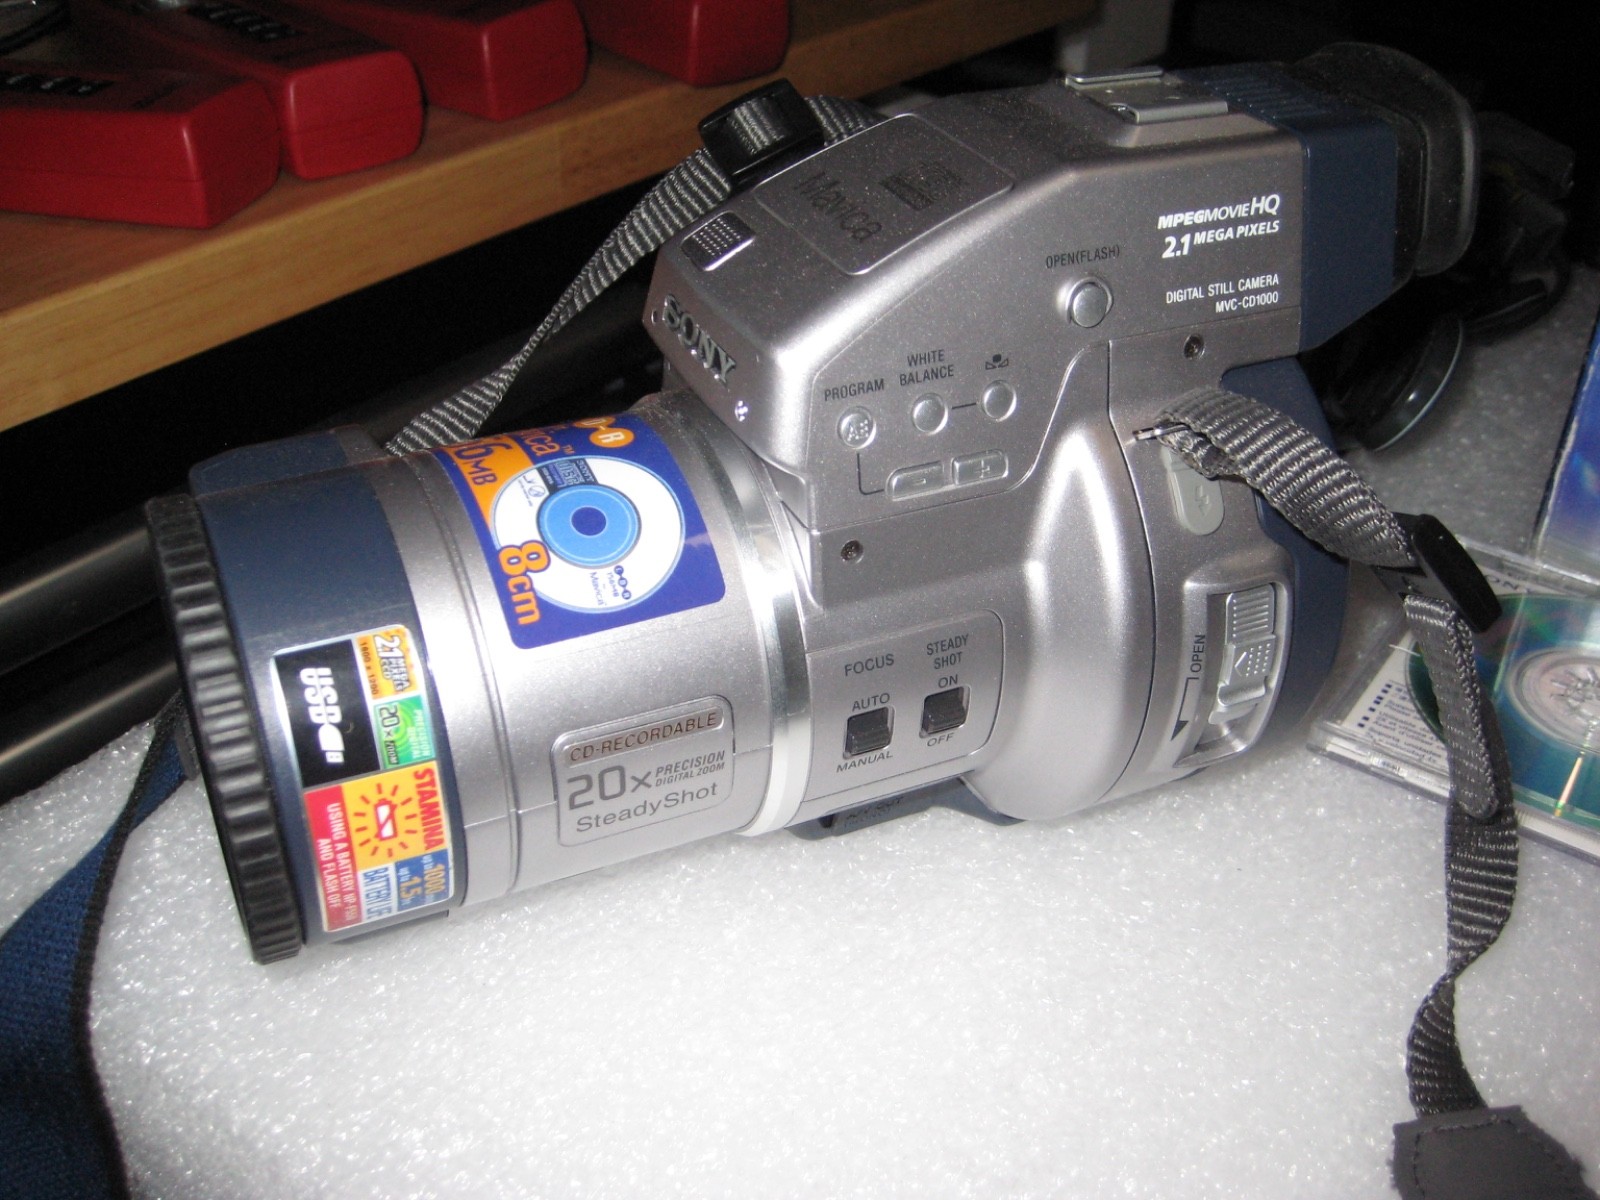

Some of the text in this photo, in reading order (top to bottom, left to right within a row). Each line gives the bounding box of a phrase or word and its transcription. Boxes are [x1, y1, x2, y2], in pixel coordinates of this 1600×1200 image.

[1162, 220, 1280, 259] 2.1 MEGA PIXELS
[1166, 274, 1280, 304] DIGITAL STILL CAMERA
[1215, 291, 1279, 313] MVC-CD1000
[662, 292, 737, 385] SONY
[907, 349, 945, 367] WHITE
[899, 365, 955, 386] BALANCE
[824, 378, 885, 402] PROGRAM
[498, 539, 552, 626] 8cm
[926, 633, 970, 656] STEADY
[1190, 634, 1206, 673] OPEN
[844, 653, 895, 676] FOCUS
[933, 652, 963, 670] SHOT
[938, 674, 958, 689] ON
[299, 666, 343, 725] USB
[852, 692, 891, 712] AUTO
[570, 711, 718, 762] CD-RECORDABLE
[926, 732, 955, 747] OFF
[655, 750, 726, 778] PRECISION
[655, 761, 726, 787] DIGITAL ZOOM
[836, 750, 894, 773] MANUAL
[413, 767, 445, 851] STAMINA
[576, 781, 718, 833] SteadyShot
[326, 802, 347, 841] USING
[316, 838, 334, 861] AND
[334, 842, 349, 851] A
[322, 862, 340, 893] FLASH
[335, 851, 356, 893] BATTERY
